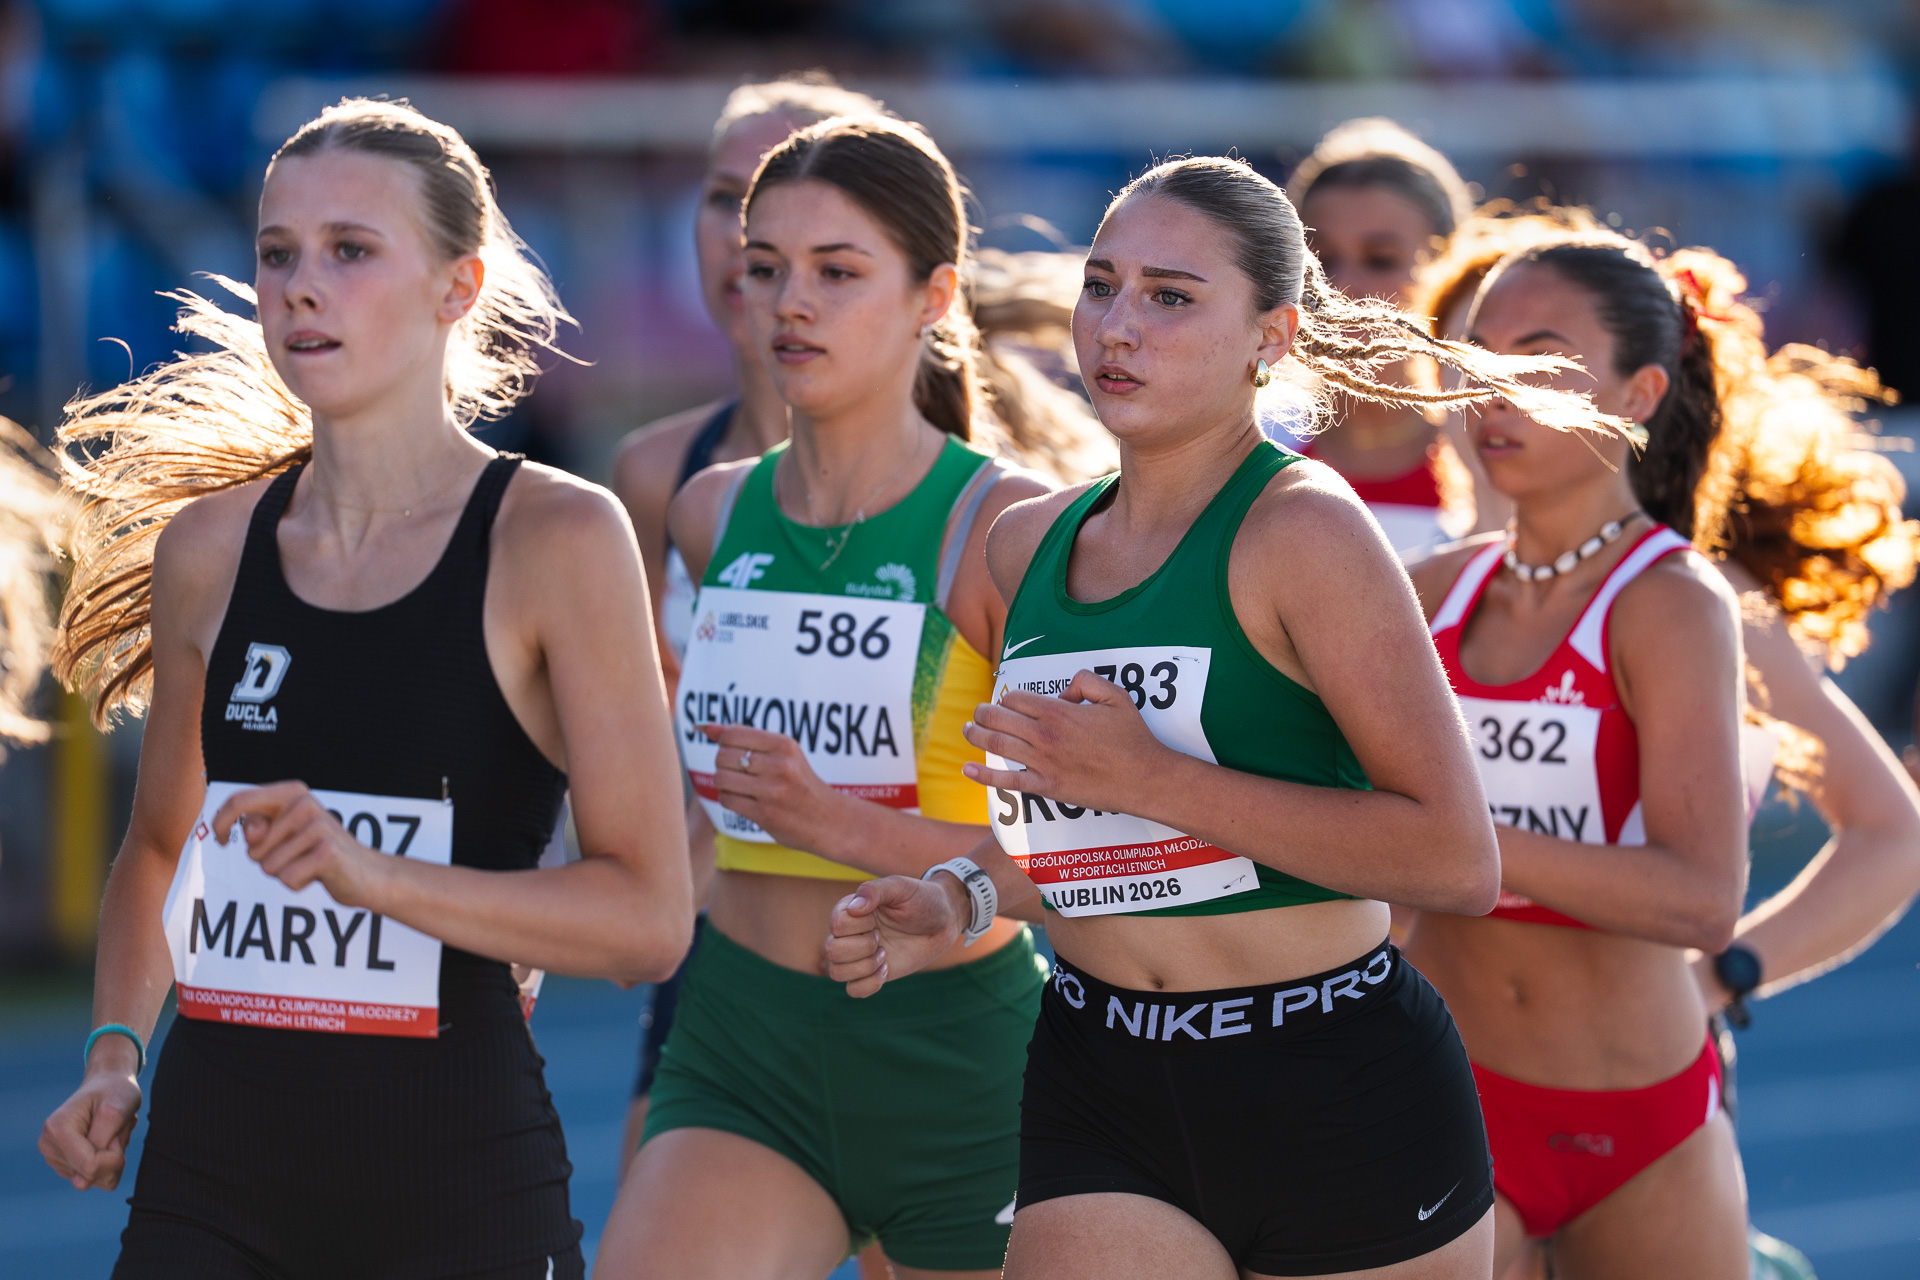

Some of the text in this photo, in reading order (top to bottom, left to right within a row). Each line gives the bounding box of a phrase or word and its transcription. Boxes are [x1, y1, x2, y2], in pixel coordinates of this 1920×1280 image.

[718, 552, 776, 589] 4F
[795, 610, 891, 660] 586
[225, 703, 278, 724] DUCLA
[1479, 717, 1568, 764] 362
[1031, 849, 1112, 869] OGÓLNOPOLSKA
[1112, 844, 1163, 860] OLIMPIADA
[1059, 858, 1167, 880] W SPORTACH LETNICH
[1052, 877, 1182, 909] LUBLIN 2026
[189, 898, 395, 972] MARYL
[195, 990, 277, 1011] OGÓLNOPOLSKA
[278, 1000, 346, 1017] OLIMPIADA
[348, 1005, 420, 1022] MŁODZIEŻY
[1105, 995, 1254, 1042] NIKE
[1272, 950, 1392, 1027] PRO
[220, 1008, 346, 1031] W SPORTACH LETNICH
